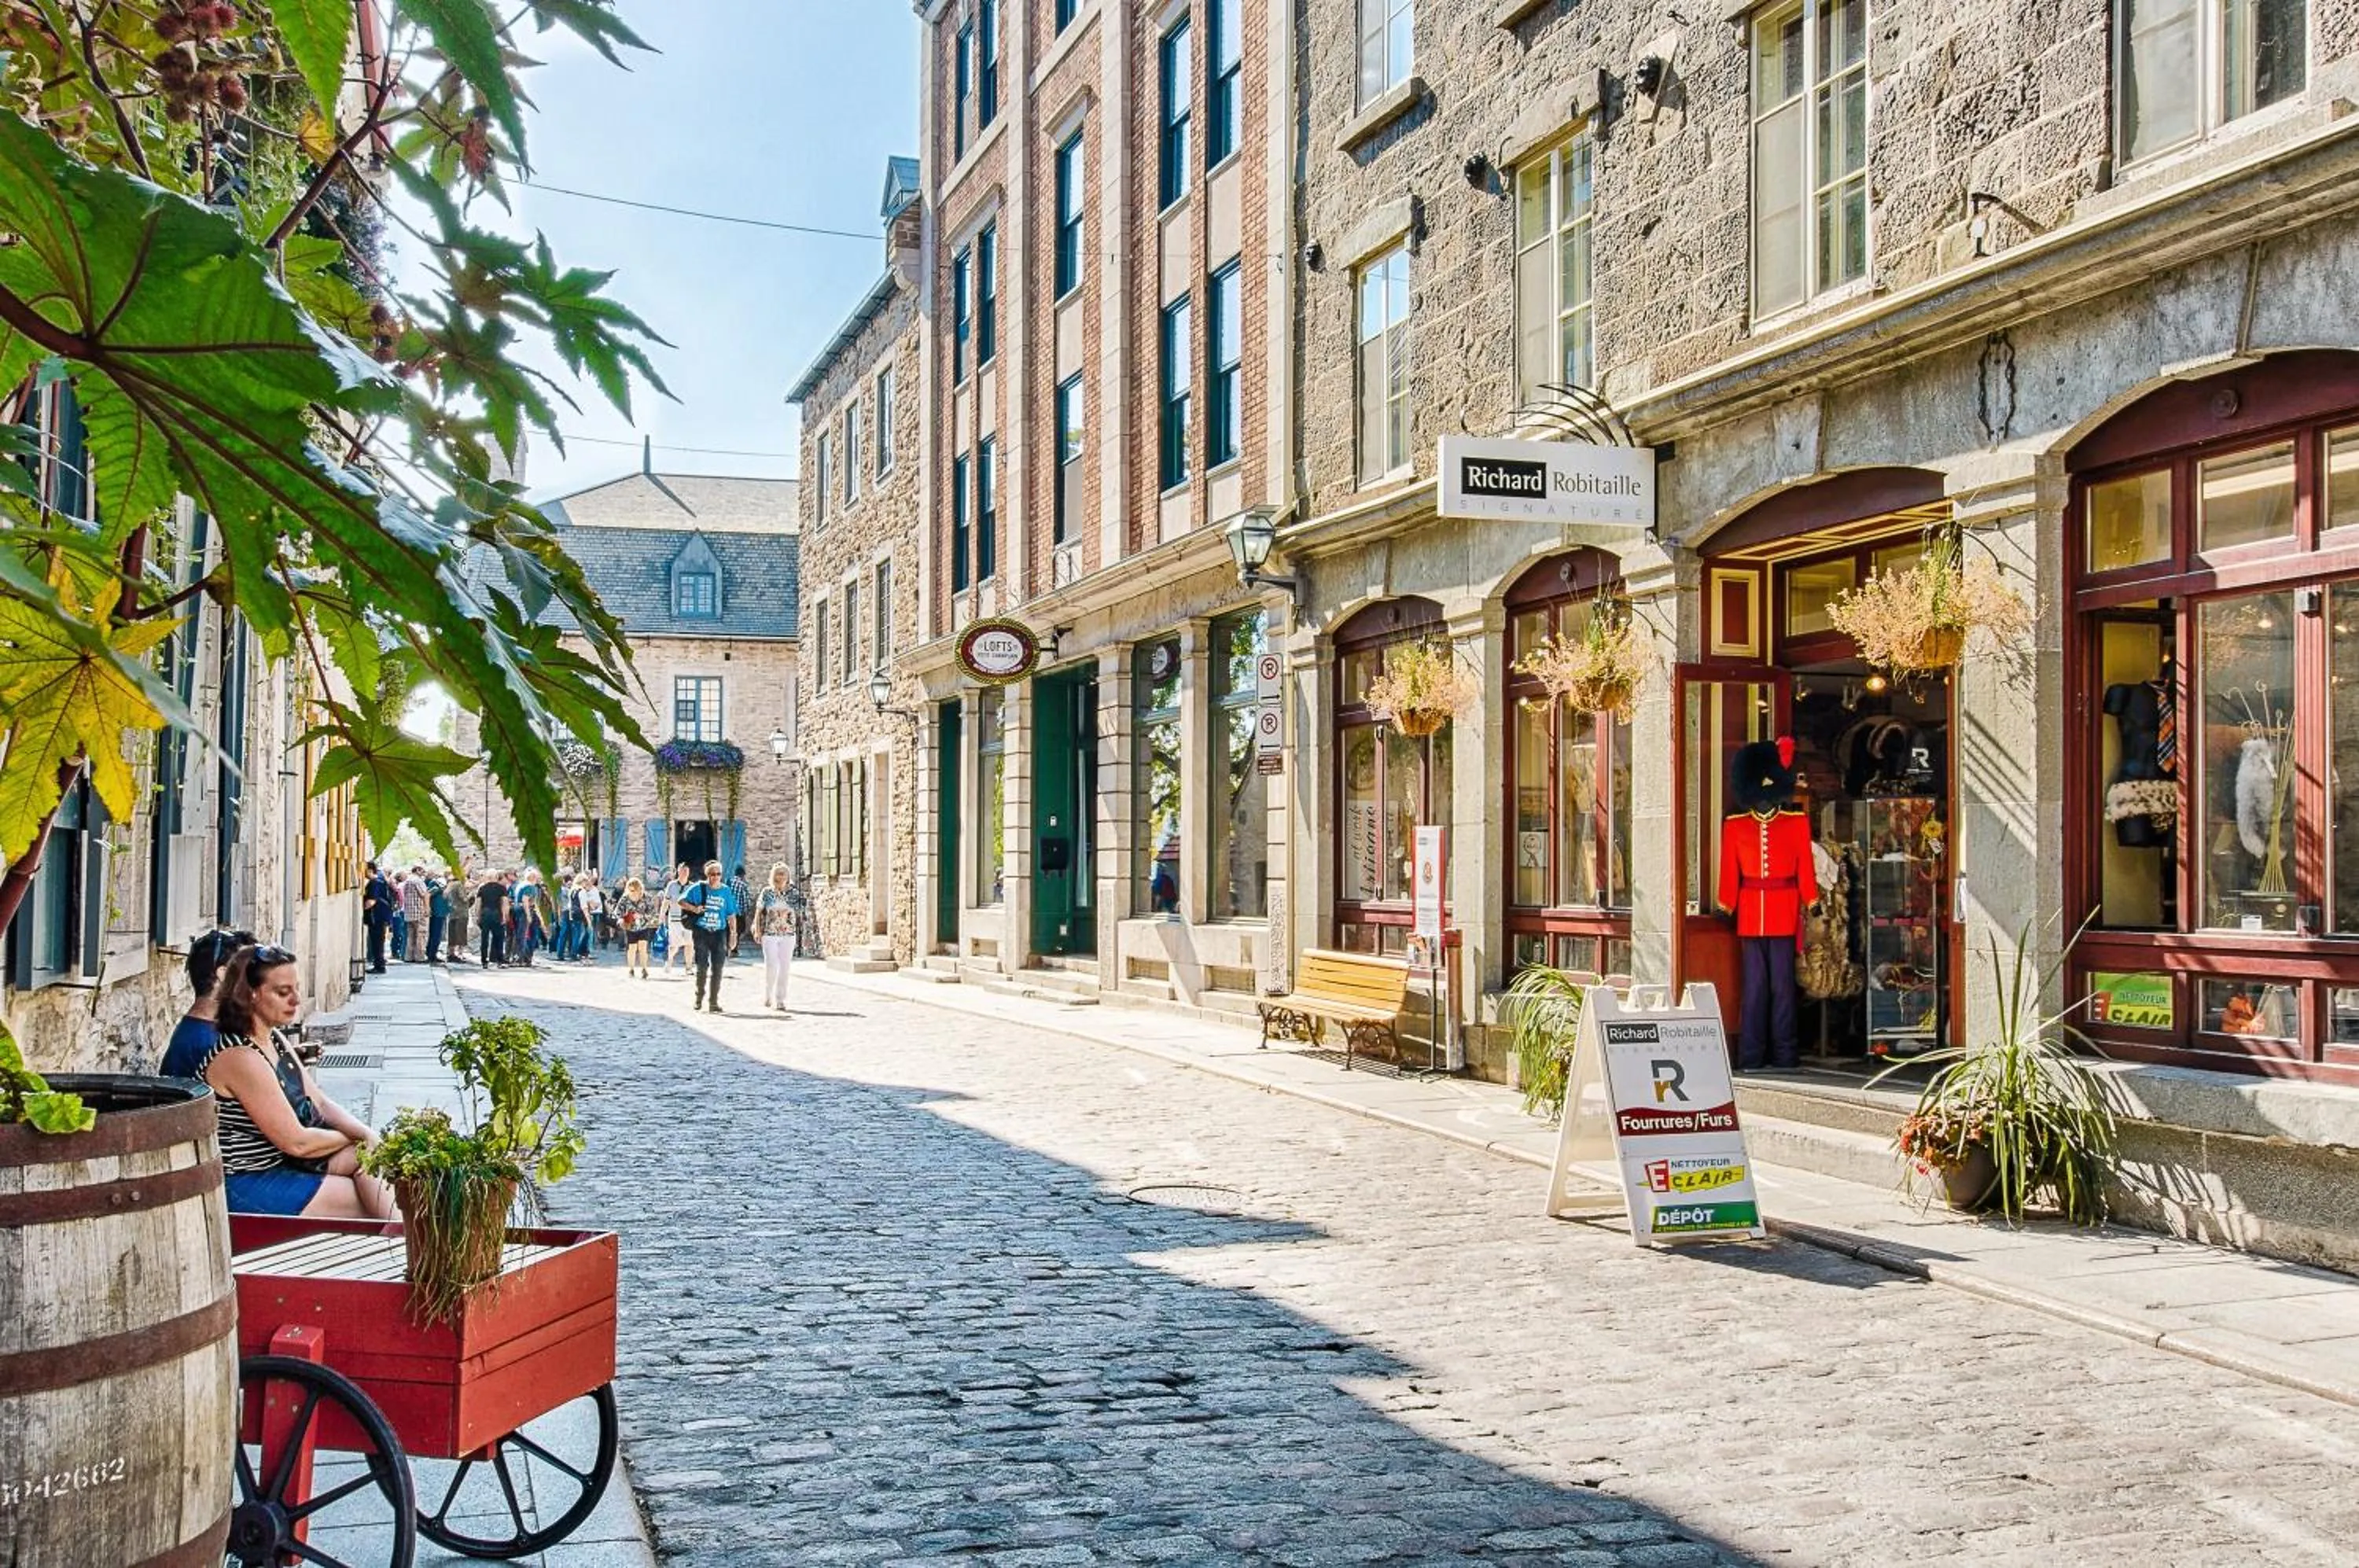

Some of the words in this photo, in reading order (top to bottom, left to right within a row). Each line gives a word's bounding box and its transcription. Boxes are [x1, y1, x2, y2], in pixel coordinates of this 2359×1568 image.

[1467, 466, 1543, 491] Richard
[1553, 472, 1641, 496] Robitaille
[1459, 500, 1642, 519] SIGNATURE
[984, 641, 1013, 652] LOFTS
[1912, 748, 1930, 767] R
[1610, 1026, 1657, 1040] Richard
[1661, 1025, 1717, 1039] Robitaille
[1621, 1113, 1733, 1131] Fourrures/Furs
[1671, 1158, 1730, 1169] NETTOYEUR
[1658, 1208, 1715, 1225] DÉPÔT
